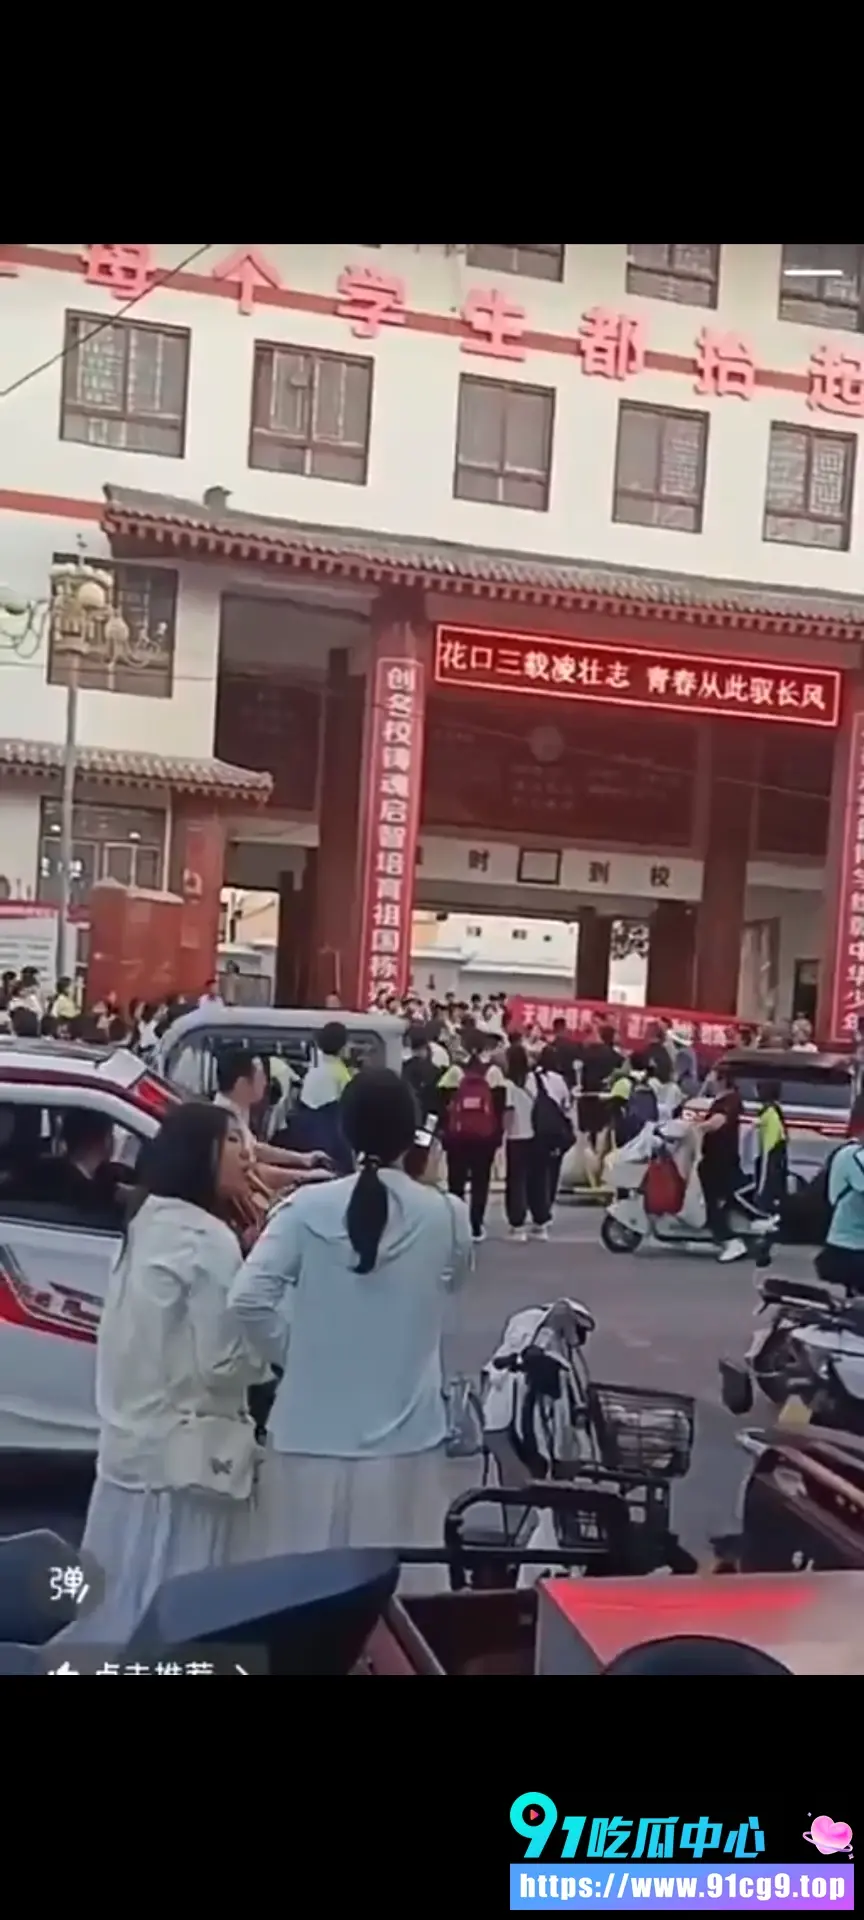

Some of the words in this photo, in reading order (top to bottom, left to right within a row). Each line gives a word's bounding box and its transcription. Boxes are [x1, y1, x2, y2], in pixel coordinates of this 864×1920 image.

[0, 244, 864, 416] 每个学生都抬起
[647, 666, 825, 710] 青春从此驭长风
